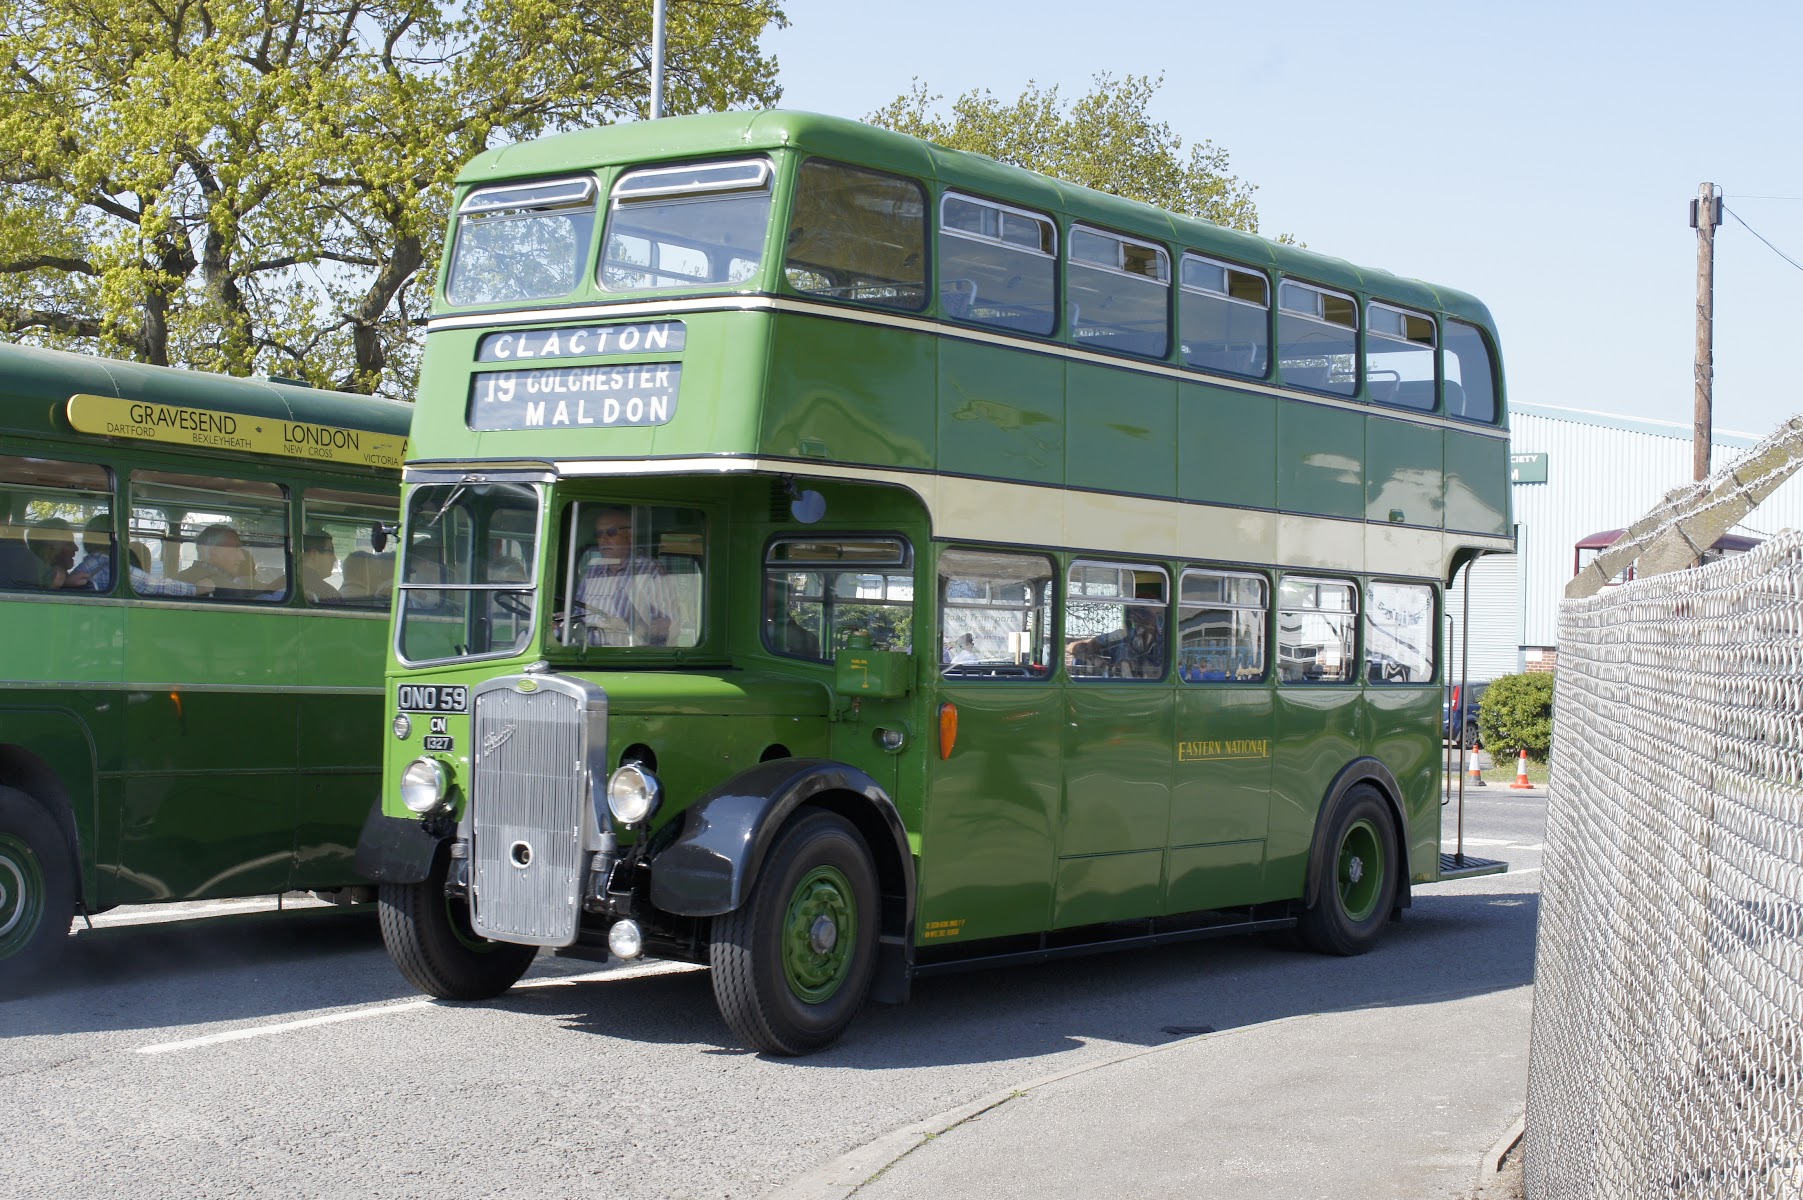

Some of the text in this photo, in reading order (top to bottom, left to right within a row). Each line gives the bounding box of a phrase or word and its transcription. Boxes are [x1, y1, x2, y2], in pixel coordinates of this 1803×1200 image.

[494, 324, 669, 358] CLACTON
[484, 372, 516, 402] 19
[525, 396, 668, 426] MALDON
[130, 404, 237, 434] GRAVESEND
[284, 424, 359, 450] LONDON
[107, 422, 398, 466] DARTFORD BEXLEYHEATH NEW CROSS VICTORIA
[959, 624, 997, 632] Museum
[970, 613, 1014, 624] Transport
[400, 686, 466, 710] ONO 59
[430, 718, 446, 732] CN
[427, 738, 450, 750] 1327
[1178, 739, 1270, 761] EASTERN NATIONAL
